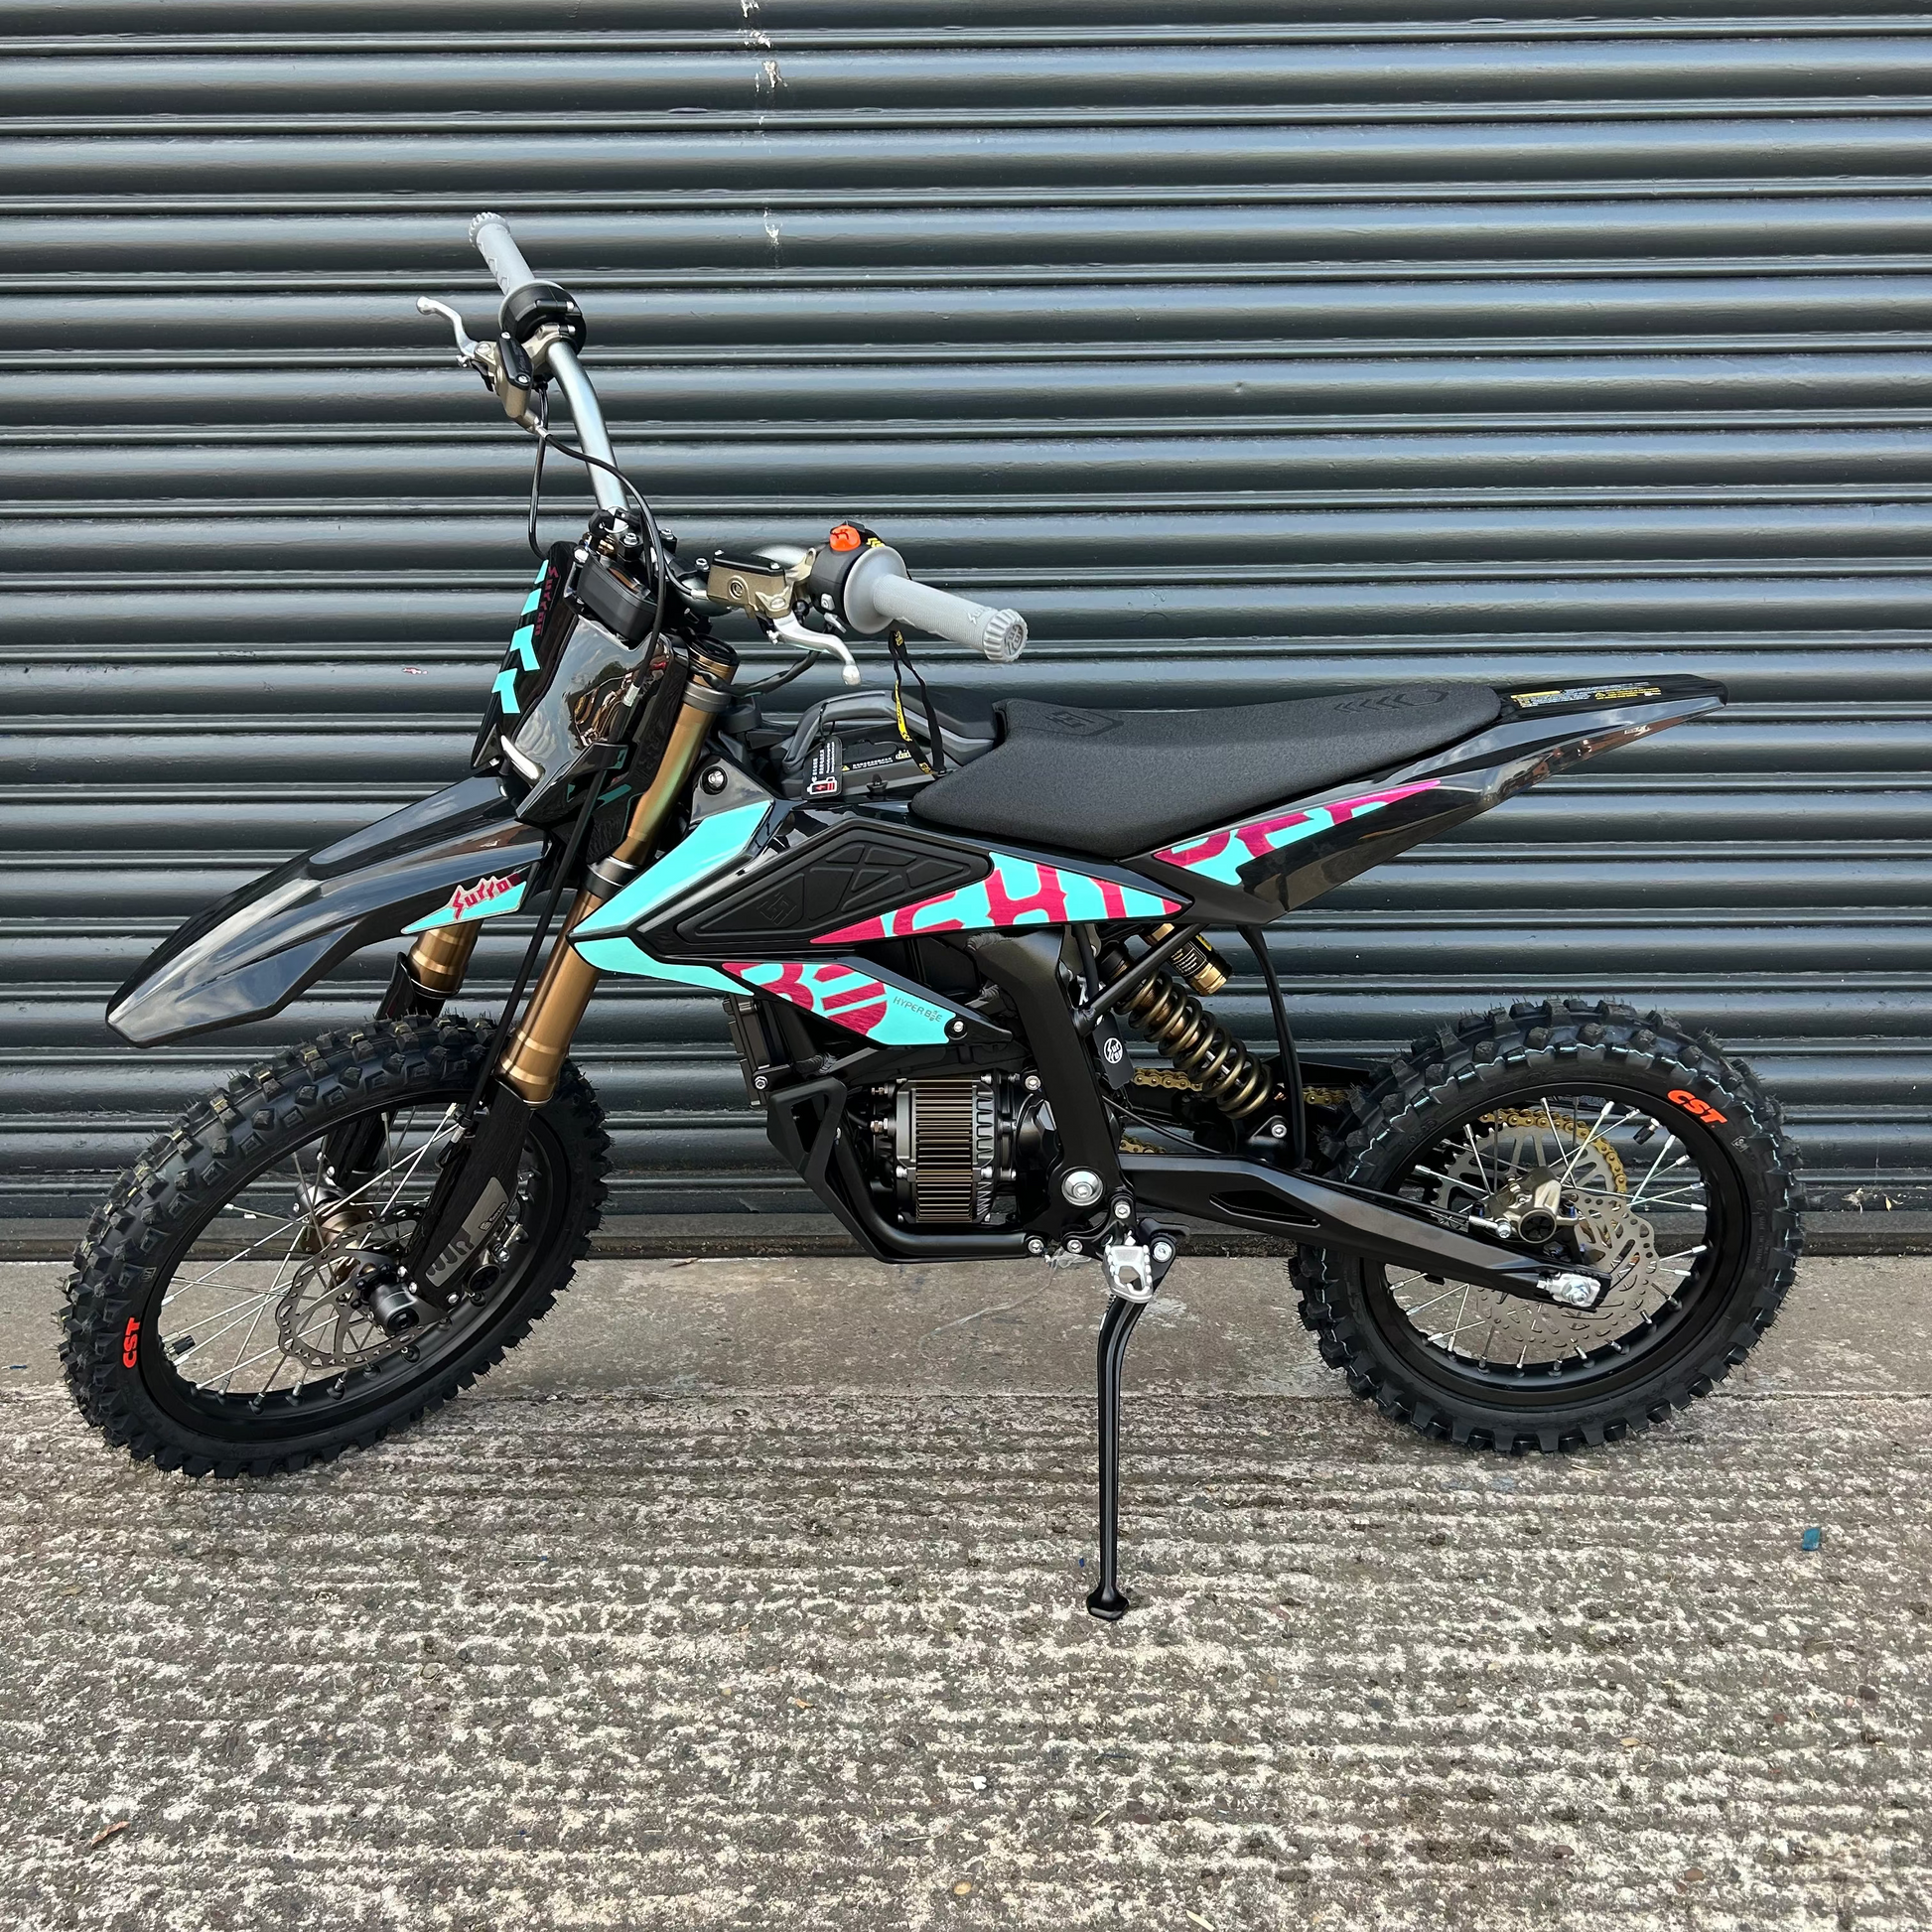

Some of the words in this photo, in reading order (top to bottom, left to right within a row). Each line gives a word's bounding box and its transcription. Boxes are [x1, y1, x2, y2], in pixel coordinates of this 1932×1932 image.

[893, 996, 924, 1015] HYPER
[1668, 1089, 1728, 1124] CST
[122, 1316, 141, 1369] CST
